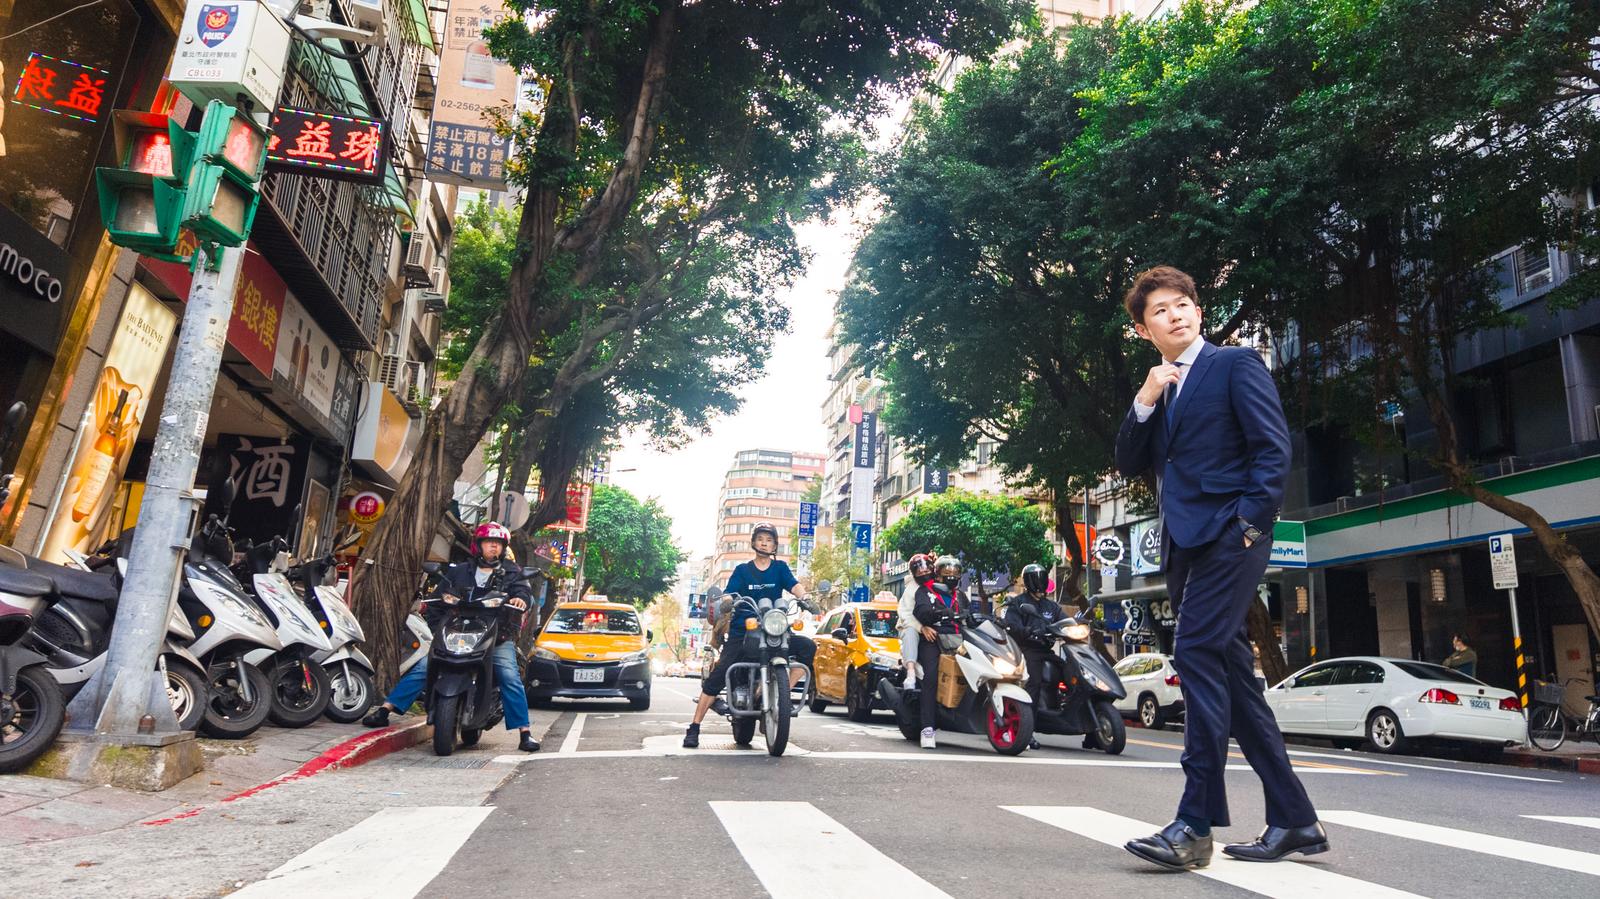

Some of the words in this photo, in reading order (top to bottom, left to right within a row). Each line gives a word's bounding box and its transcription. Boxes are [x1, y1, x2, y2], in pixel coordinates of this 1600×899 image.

[202, 32, 226, 40] POLICE
[187, 69, 221, 77] CBL033
[267, 116, 381, 170] 益珠
[229, 436, 296, 507] 酒
[1492, 540, 1500, 551] P
[1271, 547, 1304, 556] milyMart
